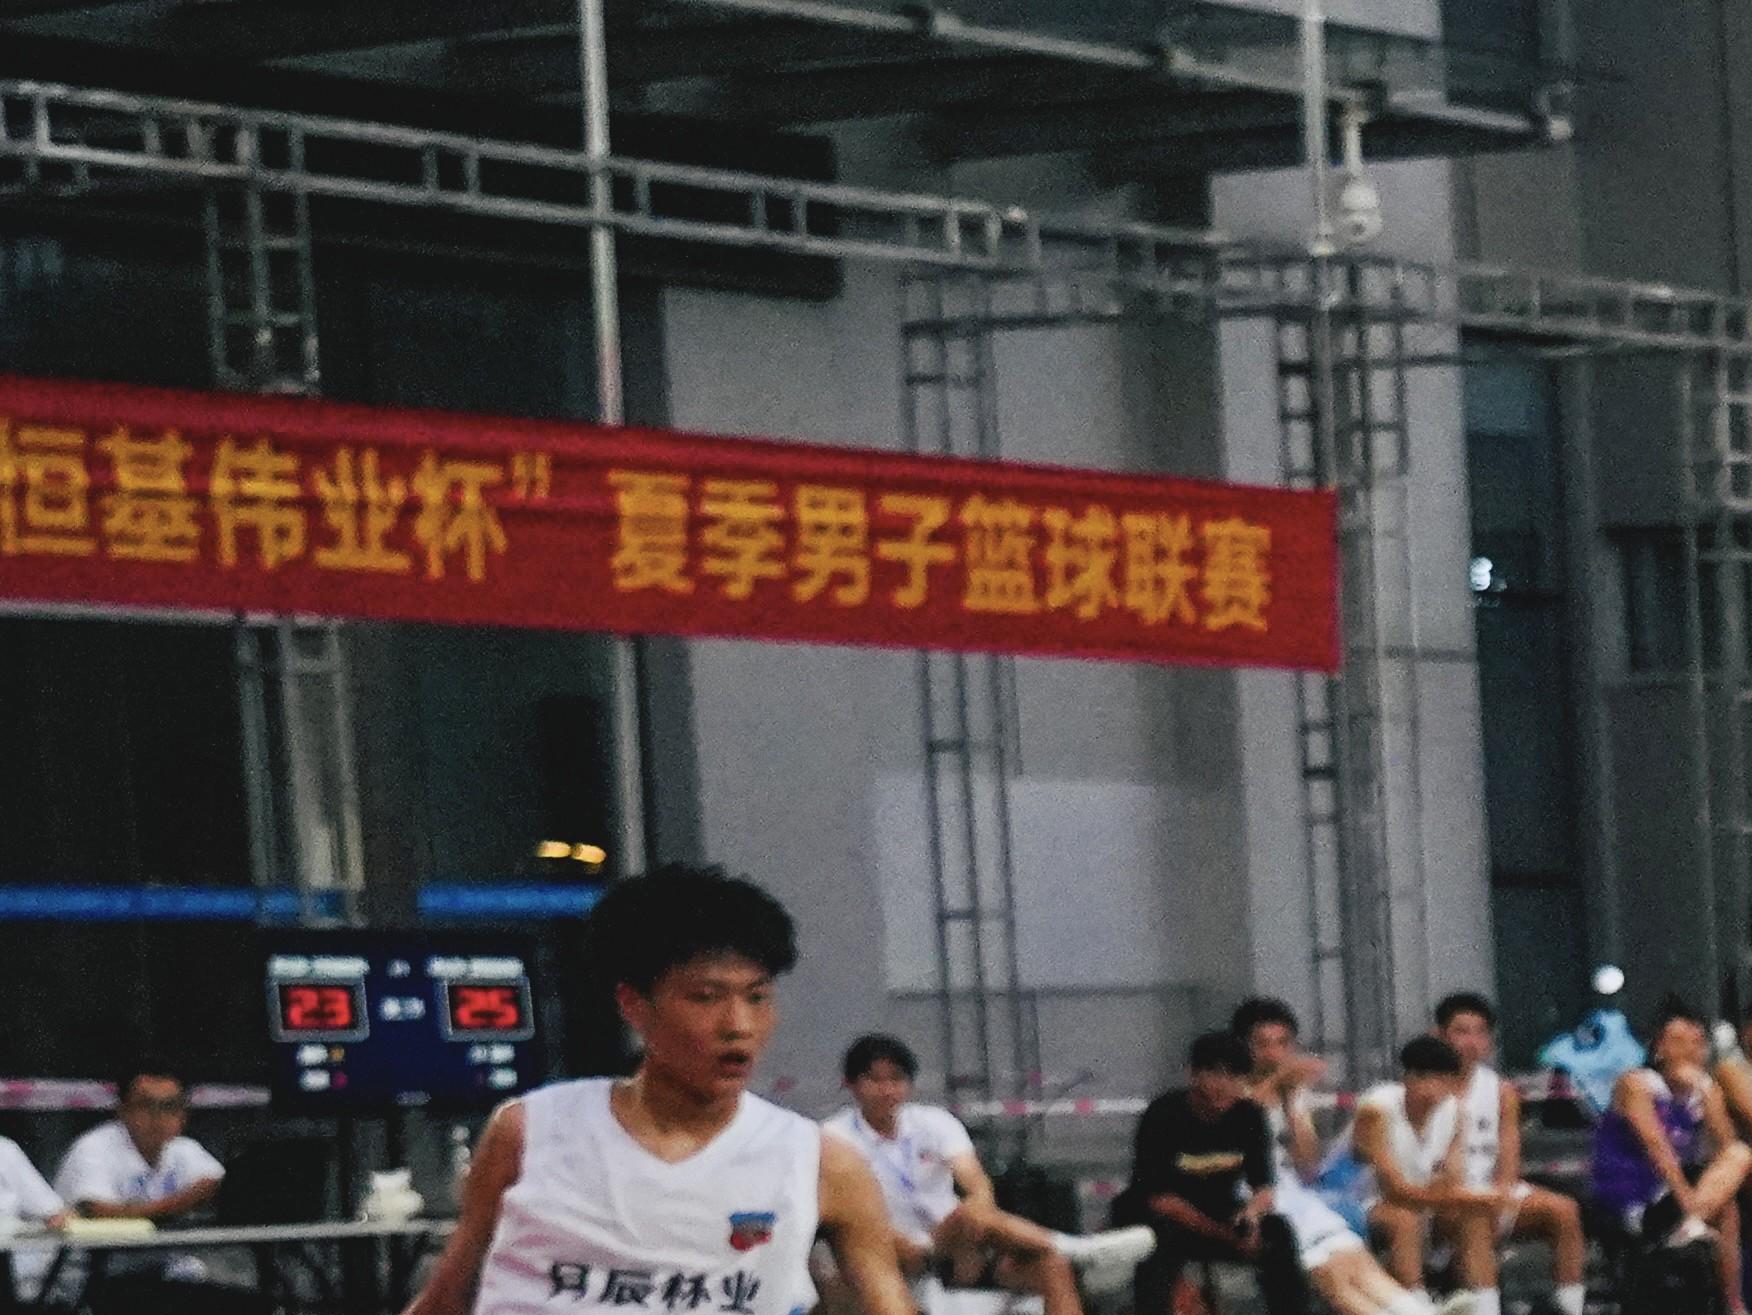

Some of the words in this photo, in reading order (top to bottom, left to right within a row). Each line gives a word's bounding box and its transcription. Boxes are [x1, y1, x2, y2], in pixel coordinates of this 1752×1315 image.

[608, 468, 1272, 632] 夏季男子篮球联赛
[287, 986, 351, 1029] 23
